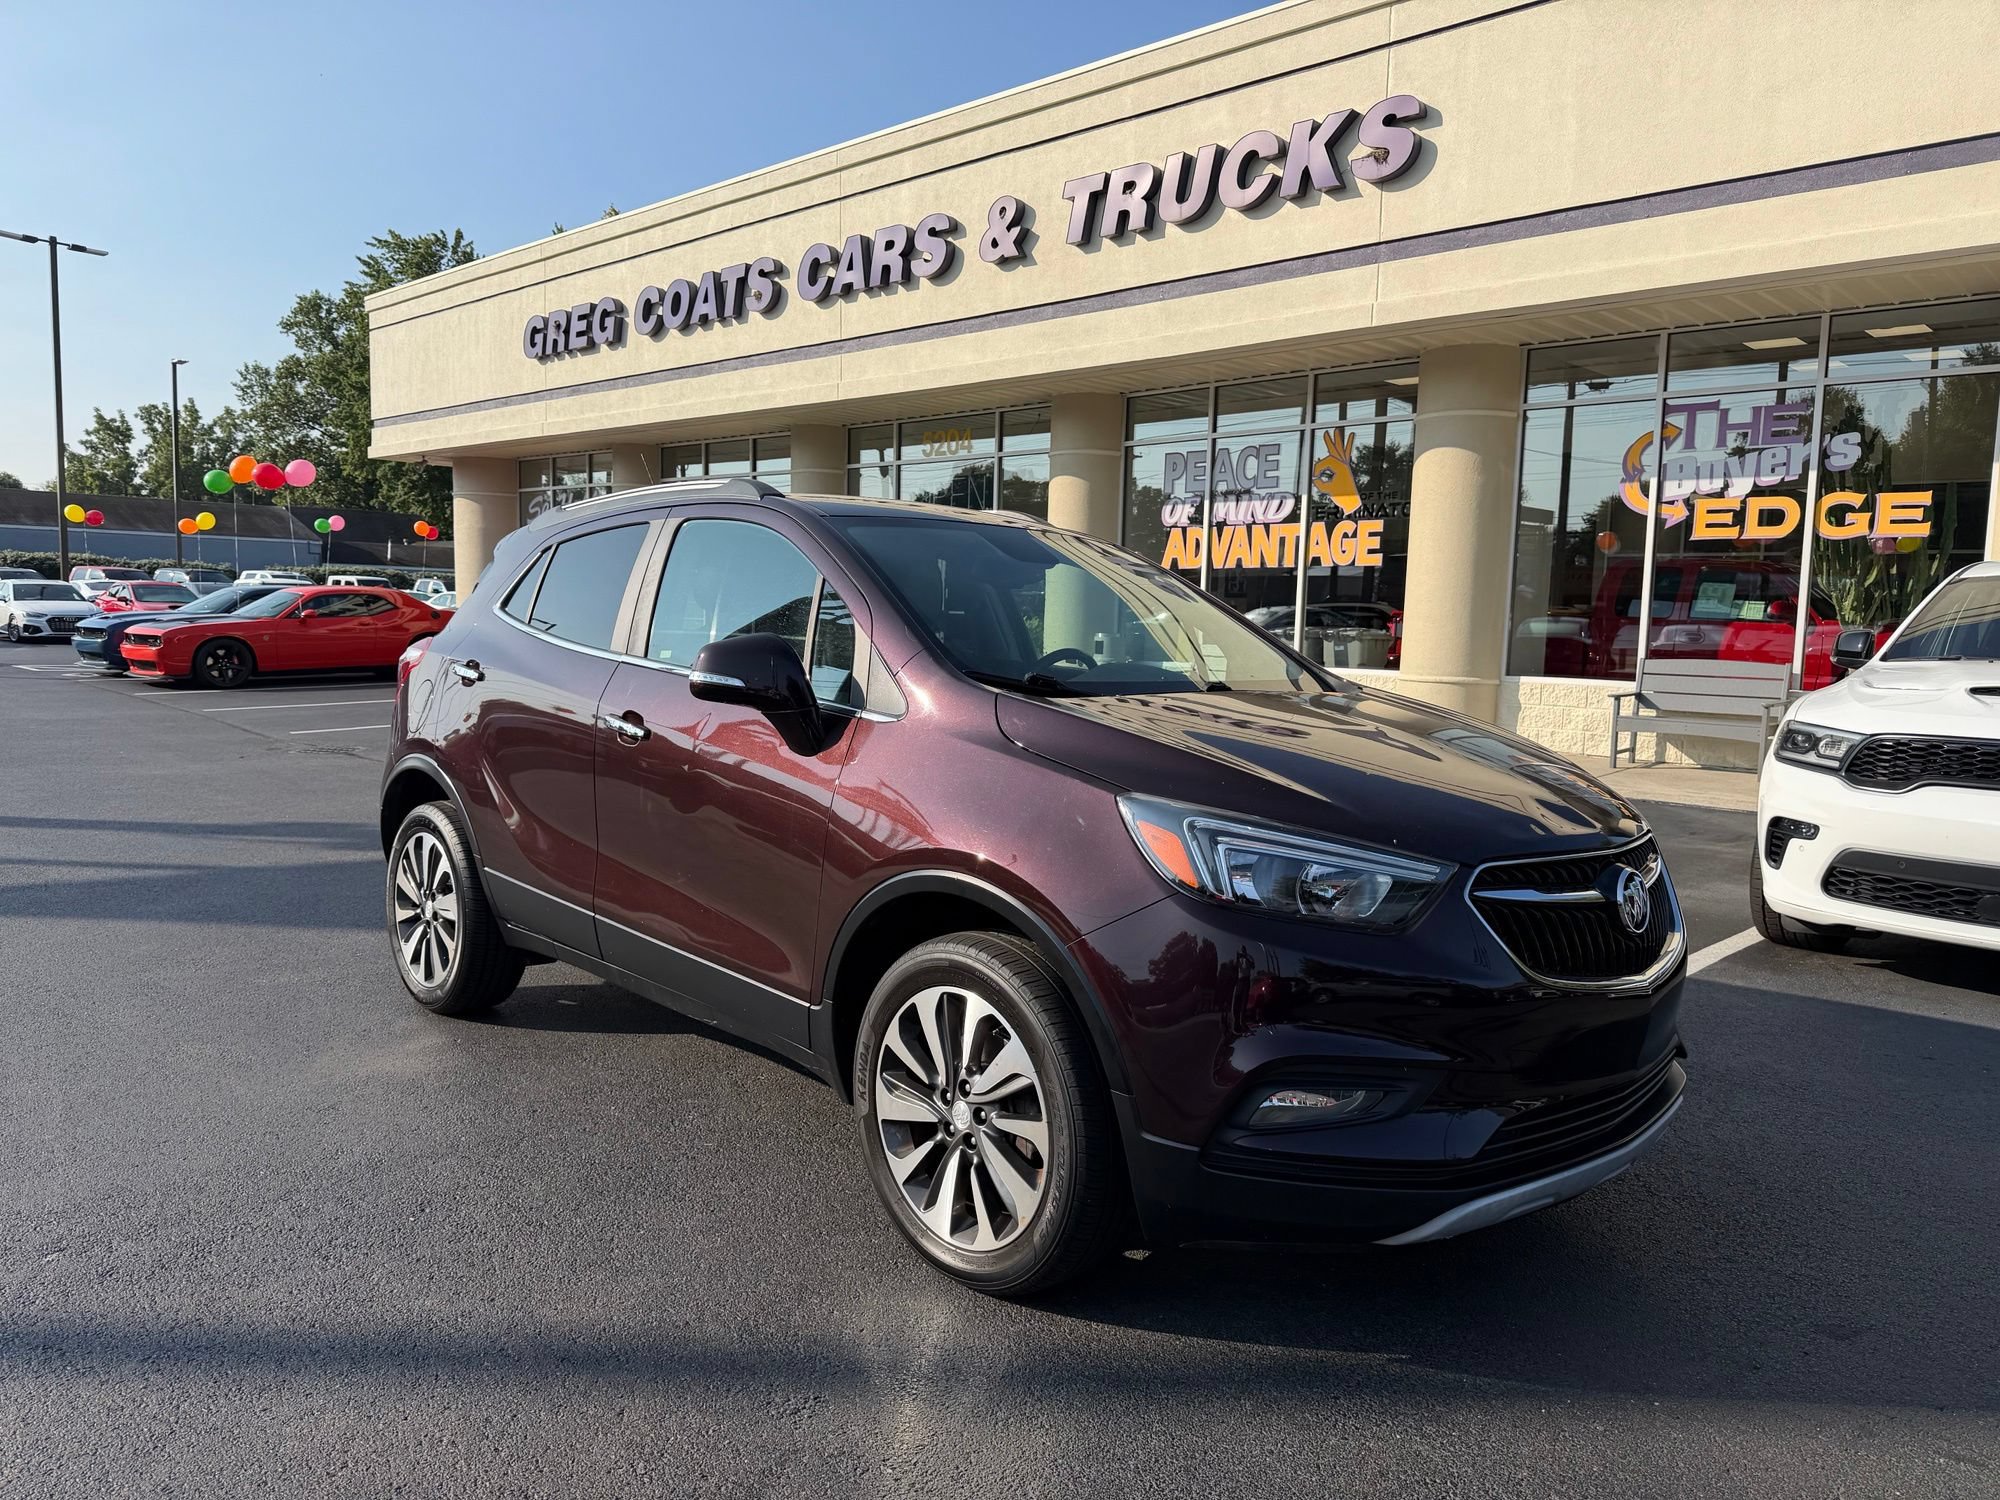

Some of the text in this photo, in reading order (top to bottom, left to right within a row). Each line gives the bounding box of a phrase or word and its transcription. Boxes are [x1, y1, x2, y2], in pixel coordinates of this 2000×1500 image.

[523, 94, 1427, 361] GREG COATS CARS & TRUCKS
[921, 427, 974, 458] 5204
[1665, 399, 1809, 450] THE
[1163, 443, 1281, 494] PEACE
[1161, 491, 1295, 527] OF MIND
[1377, 490, 1398, 500] THE
[1689, 490, 1933, 541] EDGE
[1161, 519, 1384, 570] ADVANTAGE
[857, 1040, 871, 1102] KENDA
